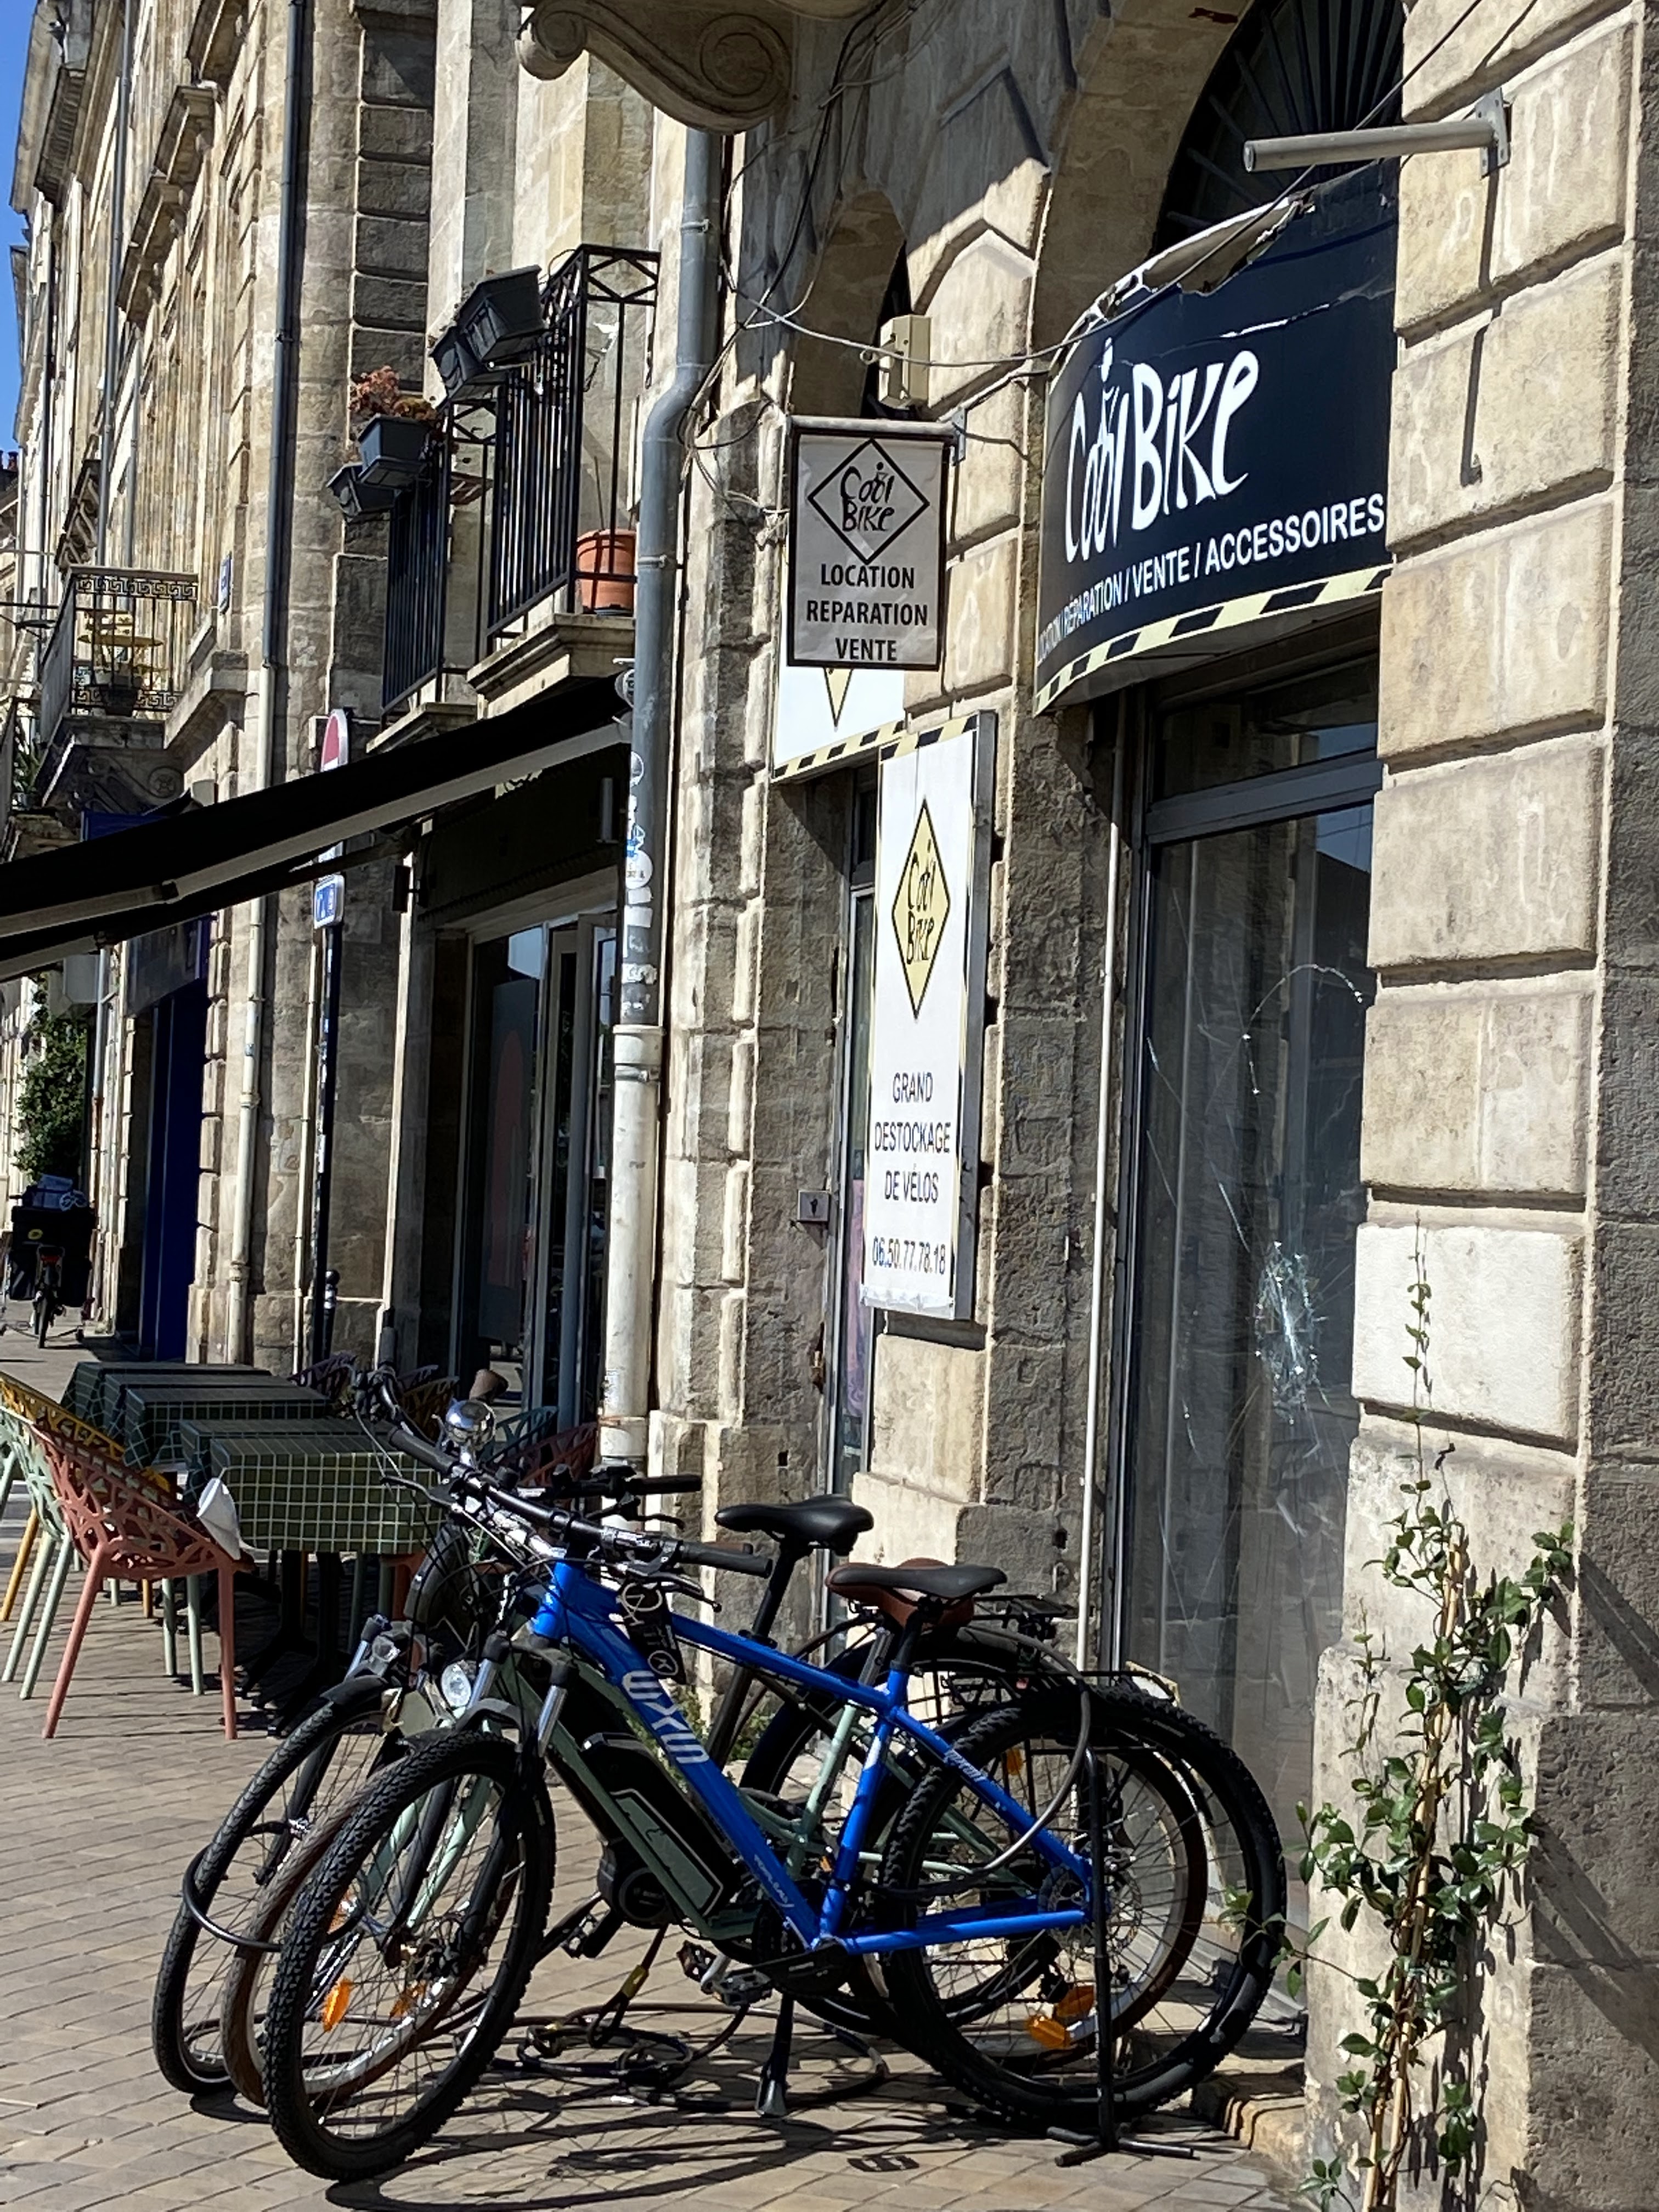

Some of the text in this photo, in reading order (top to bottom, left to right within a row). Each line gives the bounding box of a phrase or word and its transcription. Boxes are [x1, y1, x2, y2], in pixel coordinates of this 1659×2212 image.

[1132, 546, 1190, 598] VENTE
[1205, 494, 1384, 575] ACCESSOIRES
[821, 563, 915, 589] LOCATION
[806, 600, 928, 626] REPARATION
[836, 637, 897, 661] VENTE
[893, 1072, 933, 1103] GRAND
[874, 1122, 951, 1153] DESTOCKAGE
[884, 1164, 939, 1203] DE VÉLOS
